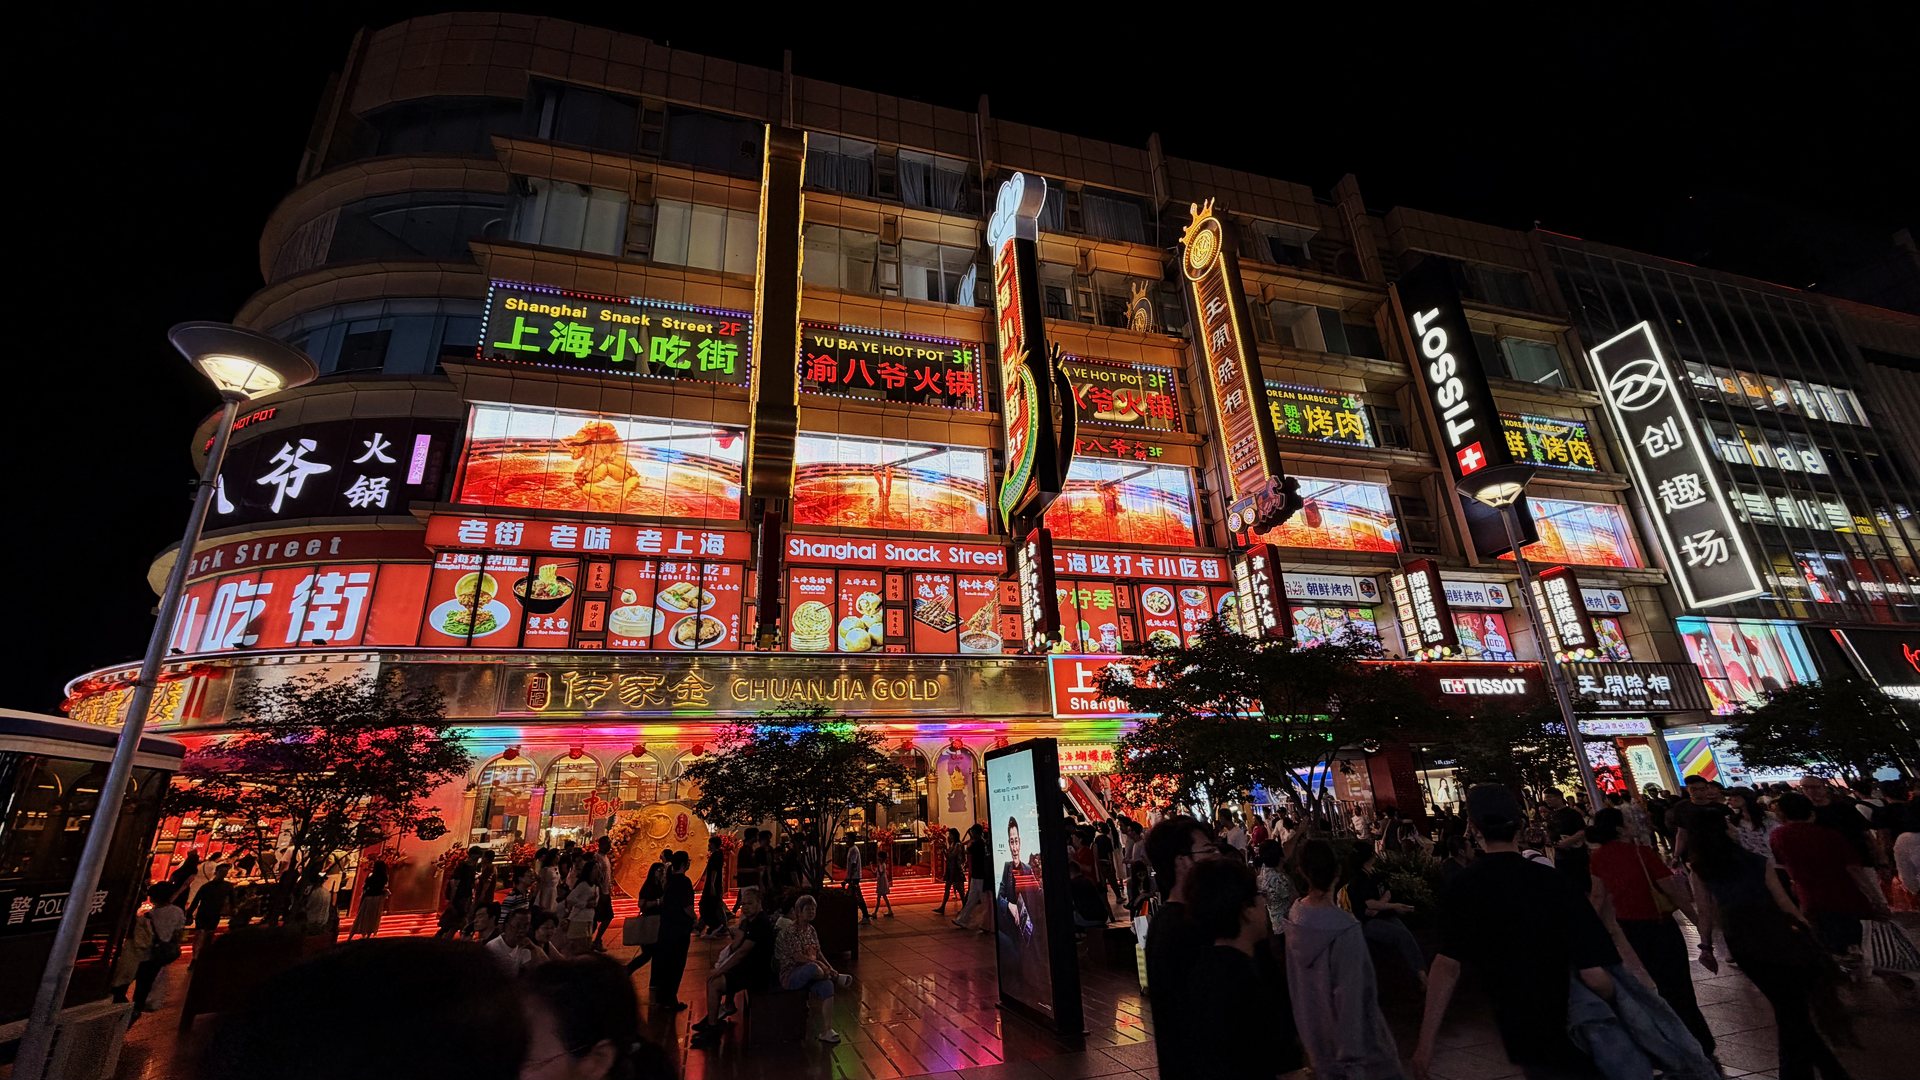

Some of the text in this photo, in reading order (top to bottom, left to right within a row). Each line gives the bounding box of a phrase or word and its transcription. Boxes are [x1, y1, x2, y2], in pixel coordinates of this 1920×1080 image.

[505, 297, 741, 336] Shanghai Snack Street 2F
[493, 316, 738, 375] 上海小吃街
[814, 335, 973, 364] YU BA YE HOT POT 3F
[1205, 296, 1244, 415] 王開照相
[805, 352, 975, 398] 渝八爷火锅
[1072, 367, 1088, 379] YE
[1090, 370, 1116, 382] HOT
[1120, 374, 1143, 385] POT
[1149, 374, 1167, 387] 3F
[1413, 307, 1476, 447] TISSOT
[1266, 389, 1295, 400] OREAN
[1298, 393, 1339, 405] BARBECUE
[232, 408, 276, 432] HOT POT
[1149, 446, 1163, 458] 3F
[343, 432, 397, 509] 火锅
[1640, 415, 1729, 568] 创趣场
[457, 519, 725, 556] 老街 老味 老上海
[189, 536, 342, 576] ack Street
[789, 539, 1003, 566] Shanghai Snack Street
[639, 562, 720, 577] 上海小吃
[1069, 588, 1115, 610] 柠季
[1306, 582, 1354, 597] 朝鲜烤肉
[561, 670, 715, 709] 传家金
[730, 678, 942, 701] CHUANJIA GOLD
[1464, 679, 1526, 694] TISSOT
[1577, 673, 1672, 697] 王開照相
[7, 896, 34, 925] 警
